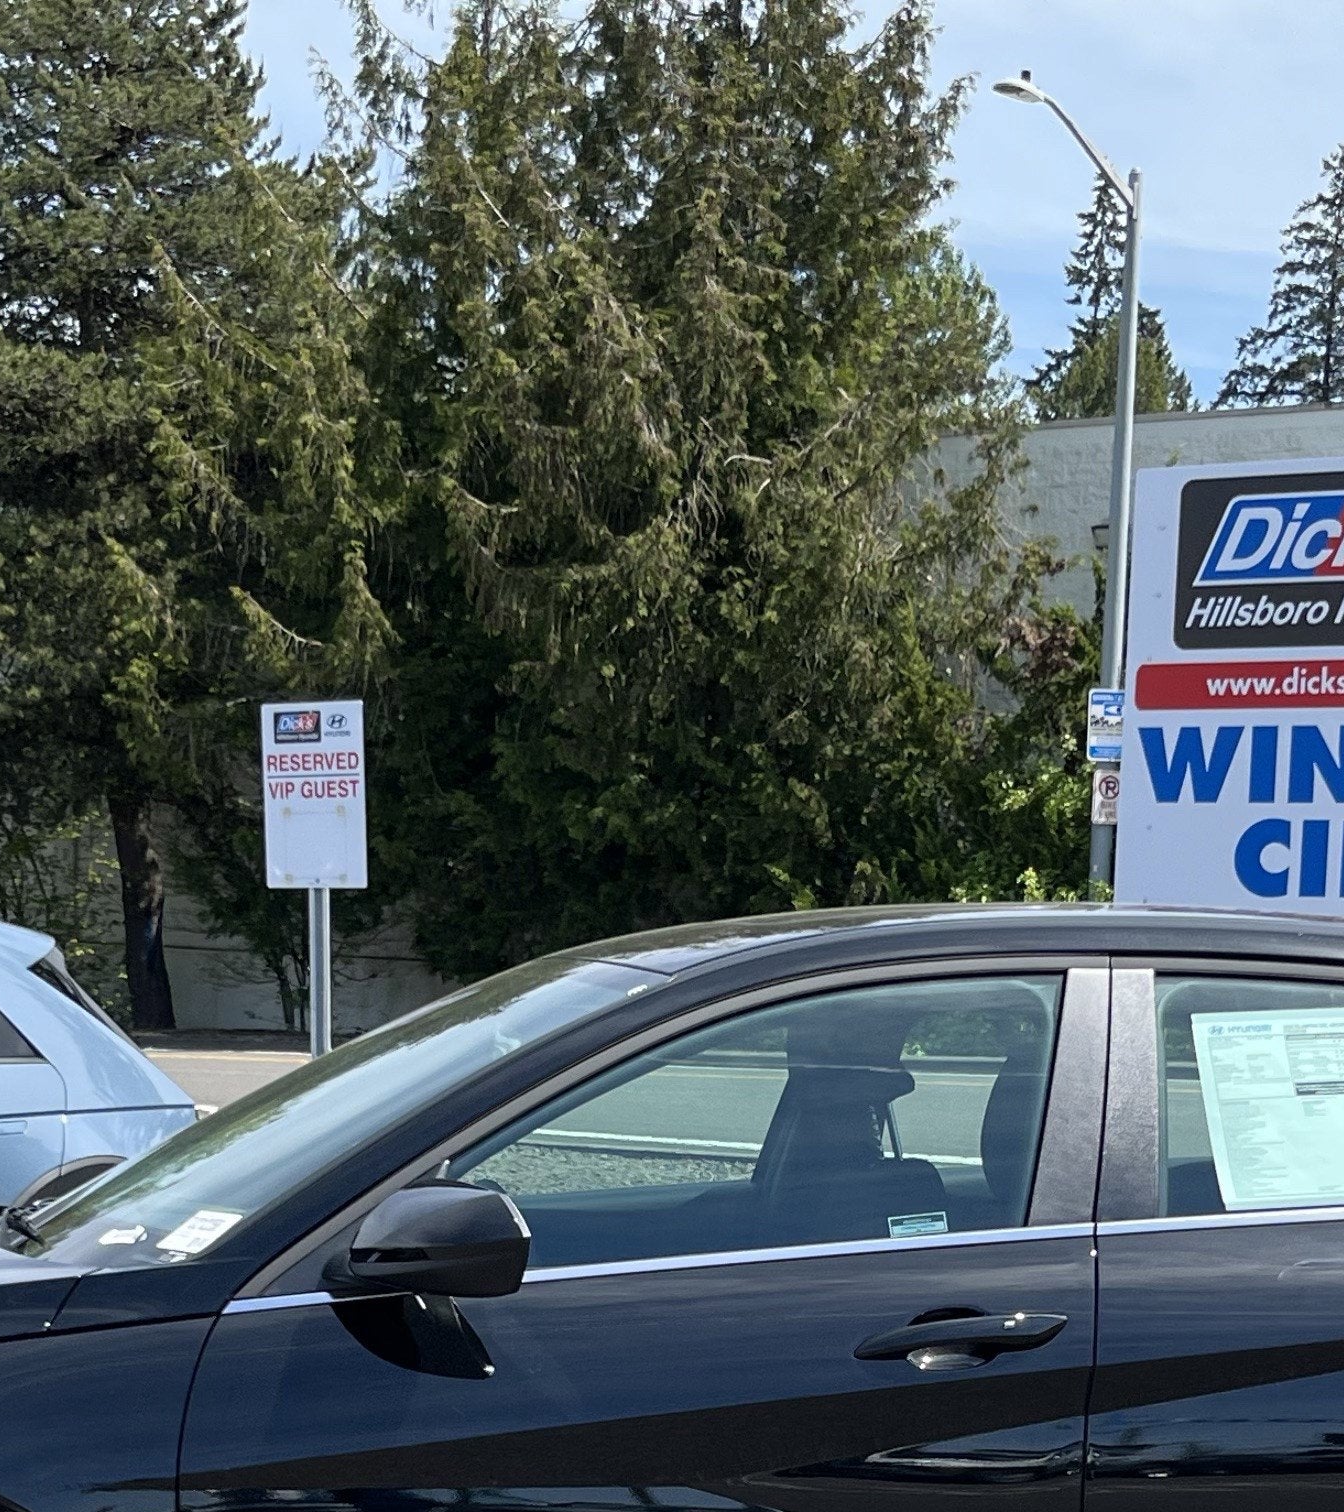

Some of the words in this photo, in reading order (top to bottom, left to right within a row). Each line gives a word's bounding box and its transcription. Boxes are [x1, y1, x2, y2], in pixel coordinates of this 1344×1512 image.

[1185, 595, 1330, 629] Hillsboro
[267, 752, 359, 772] RESERVED
[269, 782, 295, 800] VIP
[301, 780, 359, 799] GUEST
